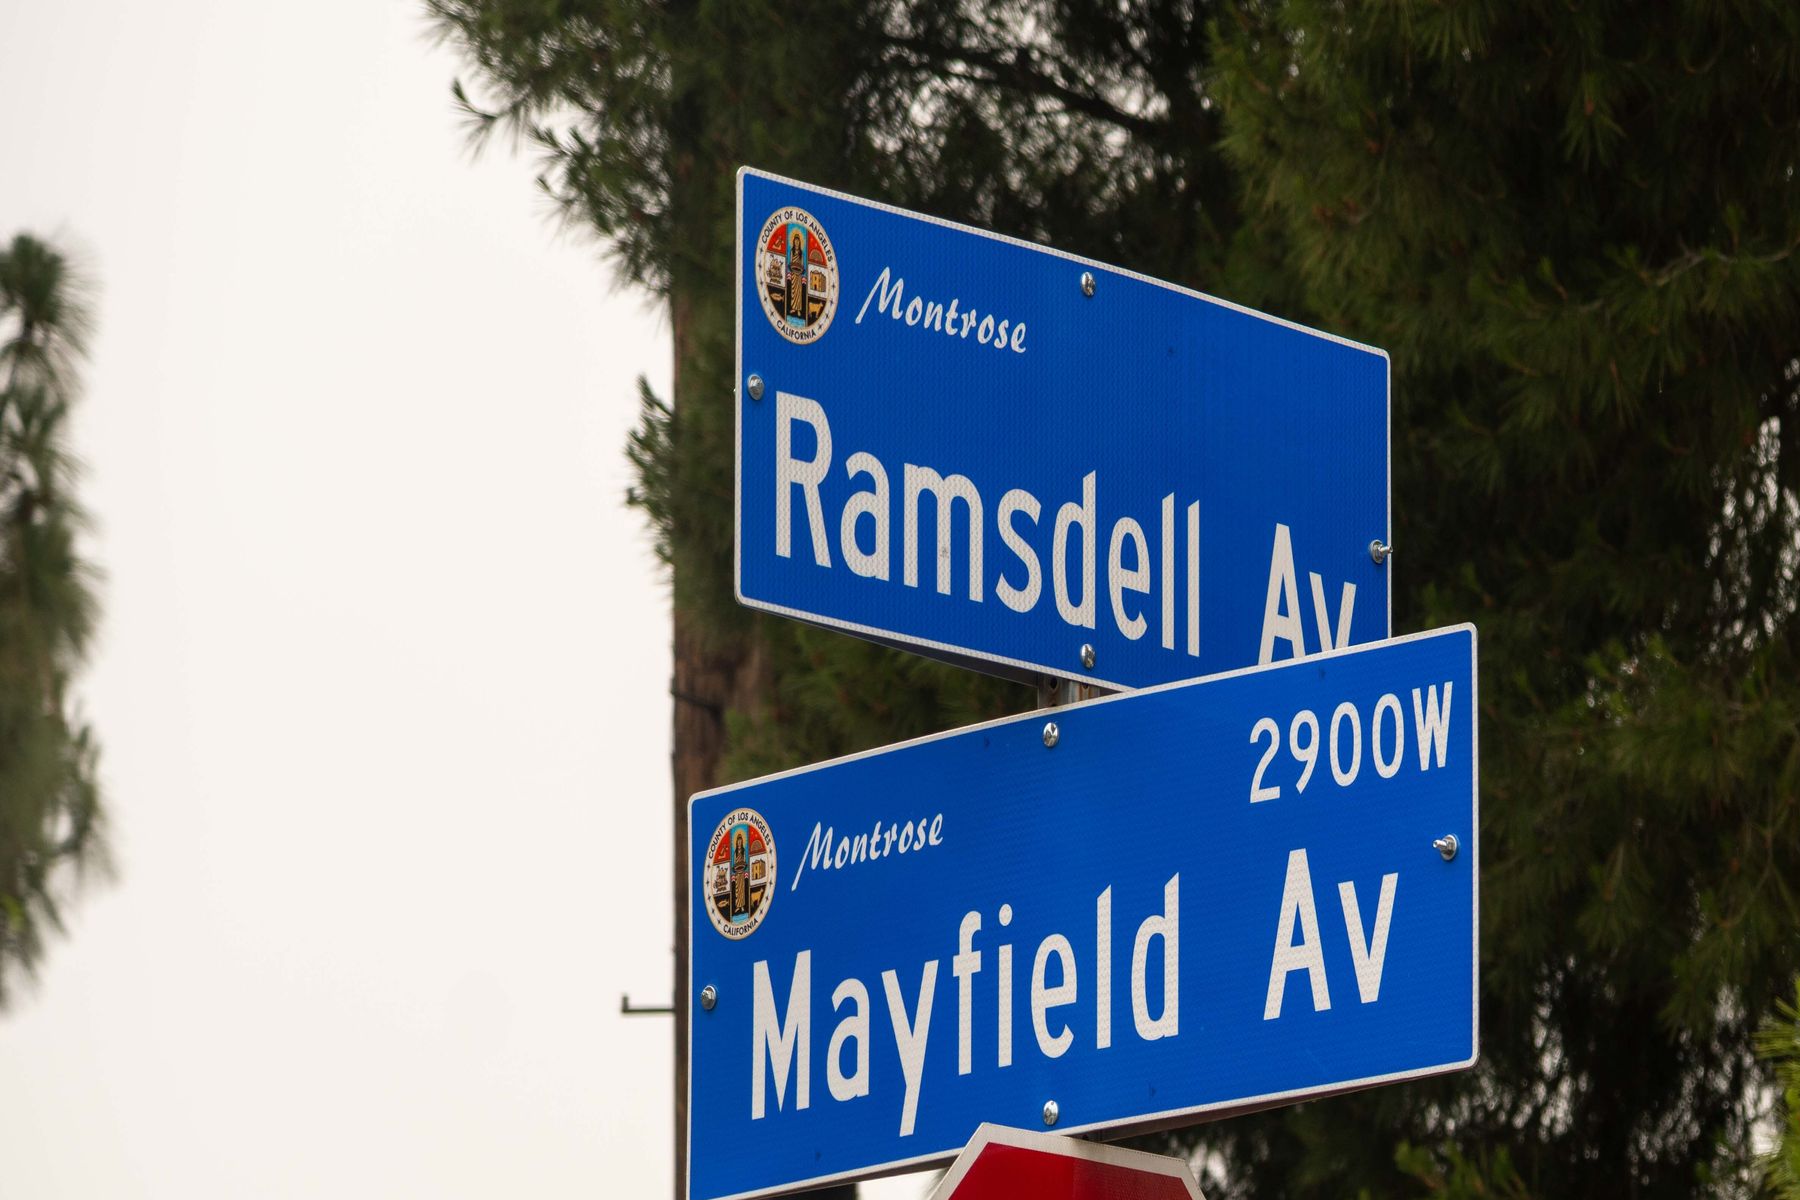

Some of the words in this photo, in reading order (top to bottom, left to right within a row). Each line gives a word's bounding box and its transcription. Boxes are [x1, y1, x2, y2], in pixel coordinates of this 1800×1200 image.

[761, 214, 783, 245] COUNTY
[784, 211, 793, 221] OF
[795, 211, 808, 224] LOS
[809, 221, 834, 263] ANGELES
[776, 319, 817, 341] CALIFORNIA
[855, 266, 1026, 353] Montrose
[775, 391, 1200, 657] Ramsdell
[1258, 522, 1357, 665] Av
[1249, 681, 1453, 804] 2900W
[708, 825, 727, 859] COUNTY
[727, 815, 736, 826] OF
[737, 812, 749, 822] LOS
[749, 816, 772, 847] ANGELES
[791, 813, 943, 892] Montrose
[723, 919, 759, 936] CALIFORNIA
[751, 872, 1180, 1137] Mayfield
[1263, 847, 1399, 1021] Av
